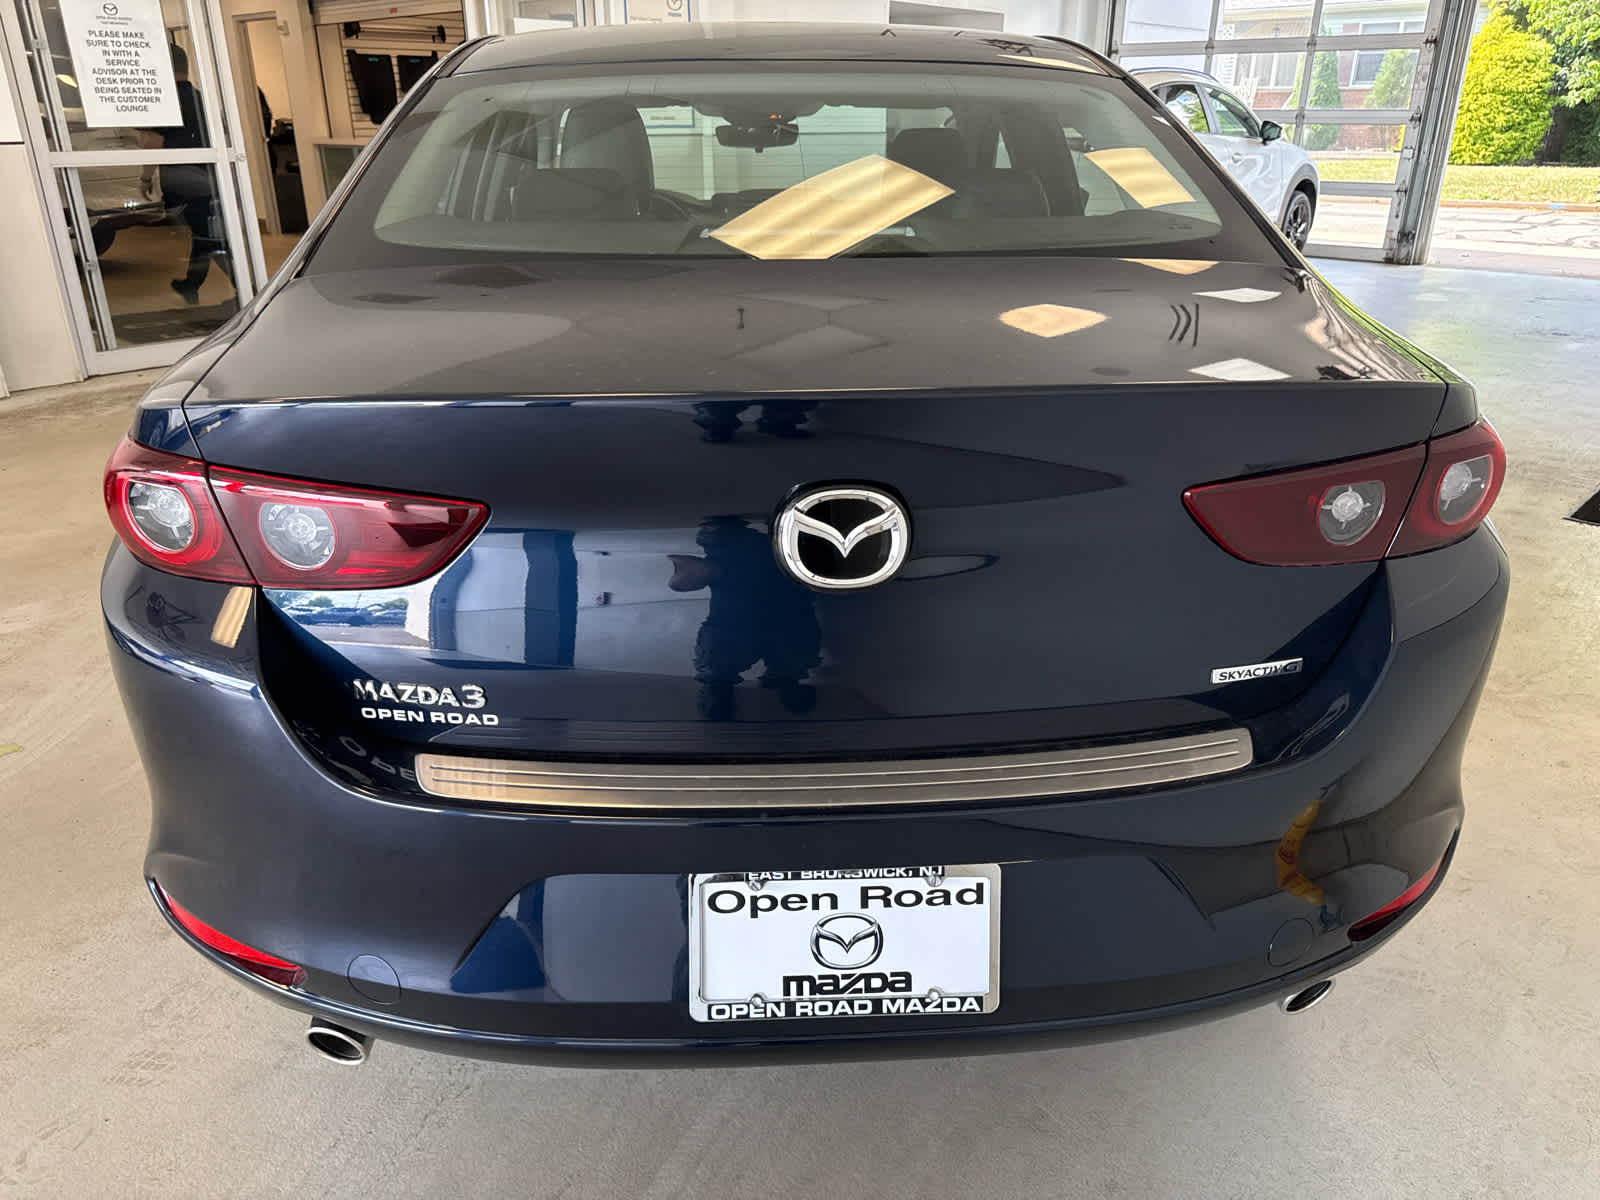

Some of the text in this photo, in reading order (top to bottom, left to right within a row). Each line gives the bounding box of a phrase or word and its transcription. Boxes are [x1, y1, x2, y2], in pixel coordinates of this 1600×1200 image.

[88, 30, 145, 39] PLEASE MAKE
[86, 39, 109, 47] SURE
[112, 49, 132, 57] WITH
[105, 59, 140, 67] SERVICE
[96, 77, 118, 85] DESK
[120, 77, 145, 85] PRIOR
[95, 86, 119, 94] BEING
[121, 86, 152, 94] SEATED
[99, 95, 116, 103] THE
[361, 707, 499, 726] OPEN ROAD
[748, 871, 792, 880] EAST
[707, 882, 984, 919] Open Road
[710, 997, 981, 1020] OPEN ROAD MAZDA
